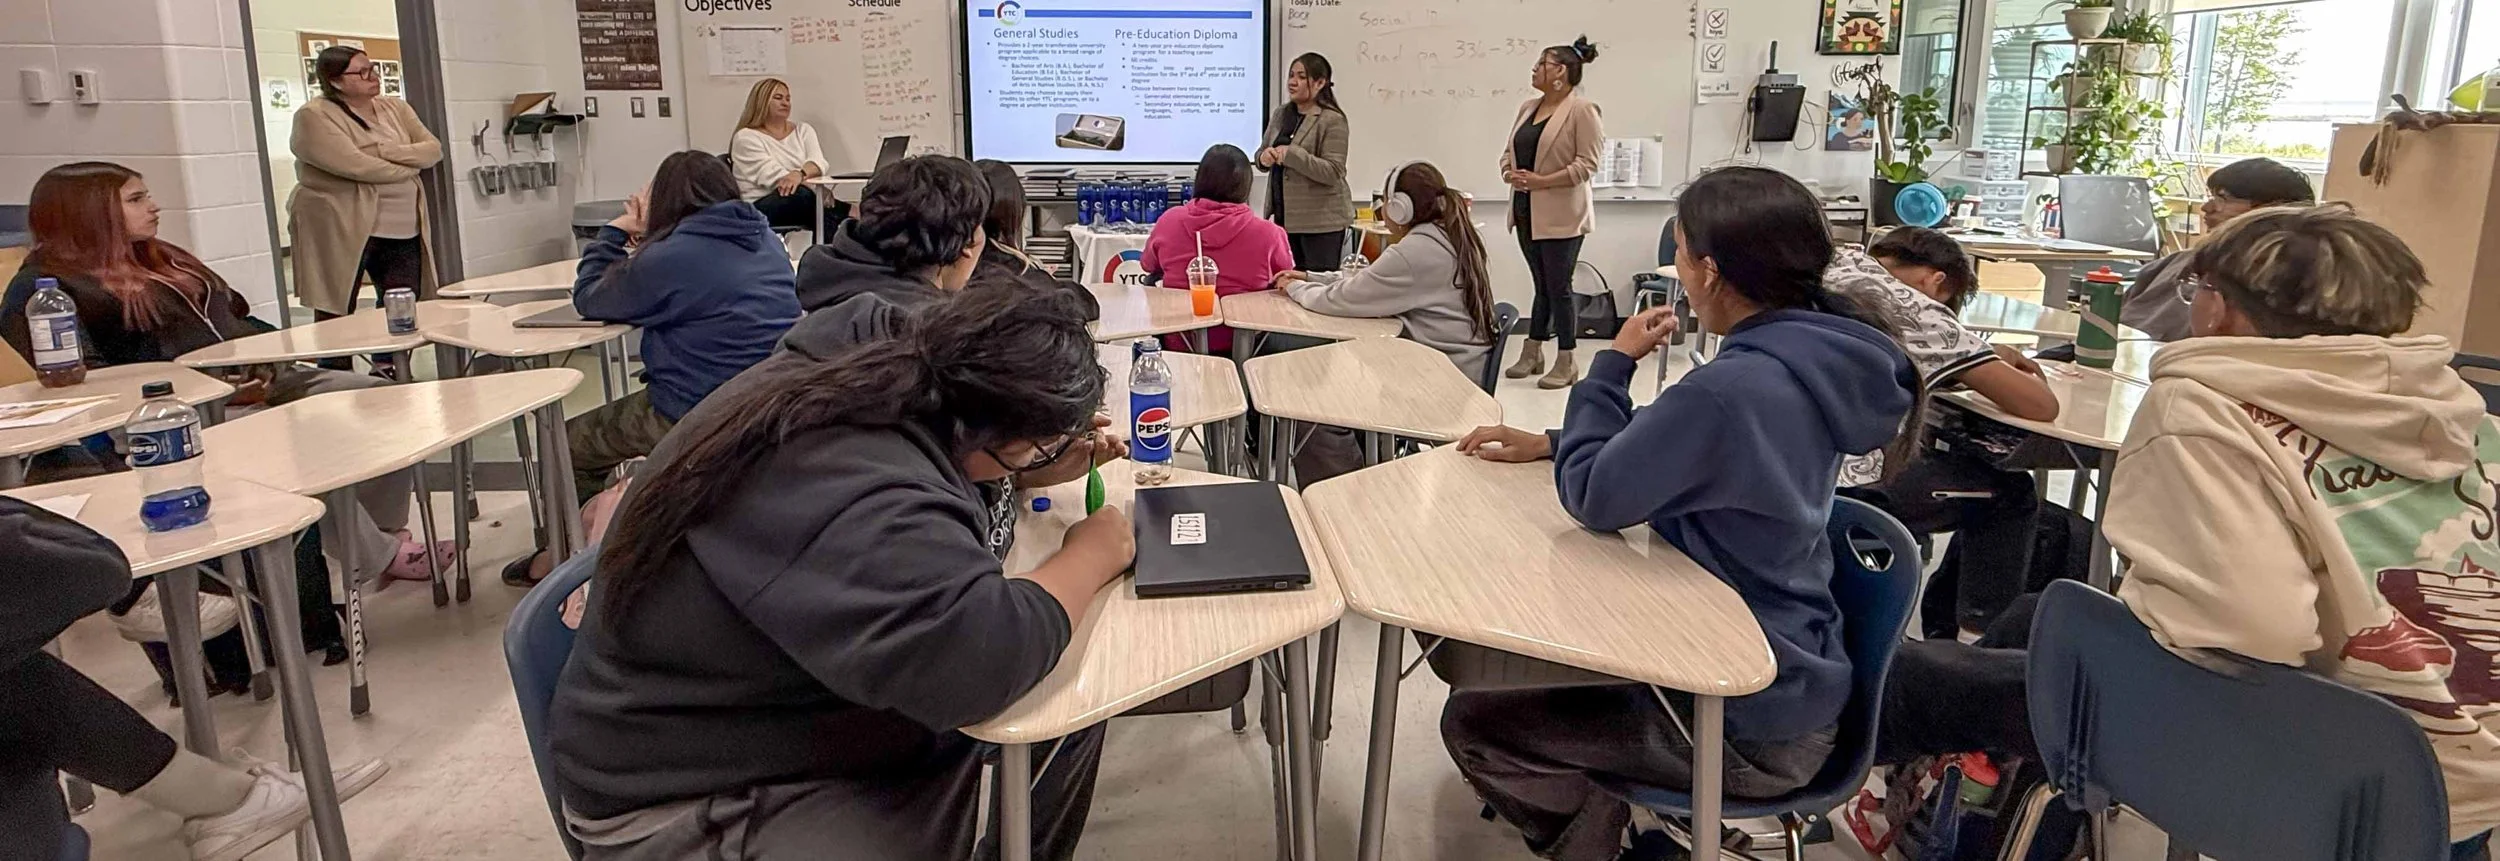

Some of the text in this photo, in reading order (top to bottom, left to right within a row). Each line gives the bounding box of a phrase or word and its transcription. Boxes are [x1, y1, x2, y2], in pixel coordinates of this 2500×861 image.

[685, 0, 772, 15] Objectives
[993, 27, 1079, 39] General Studies
[1115, 28, 1238, 41] Pre-Education Diploma
[1357, 41, 1402, 64] Read
[1119, 274, 1147, 285] YTC
[1177, 515, 1202, 539] 15112
